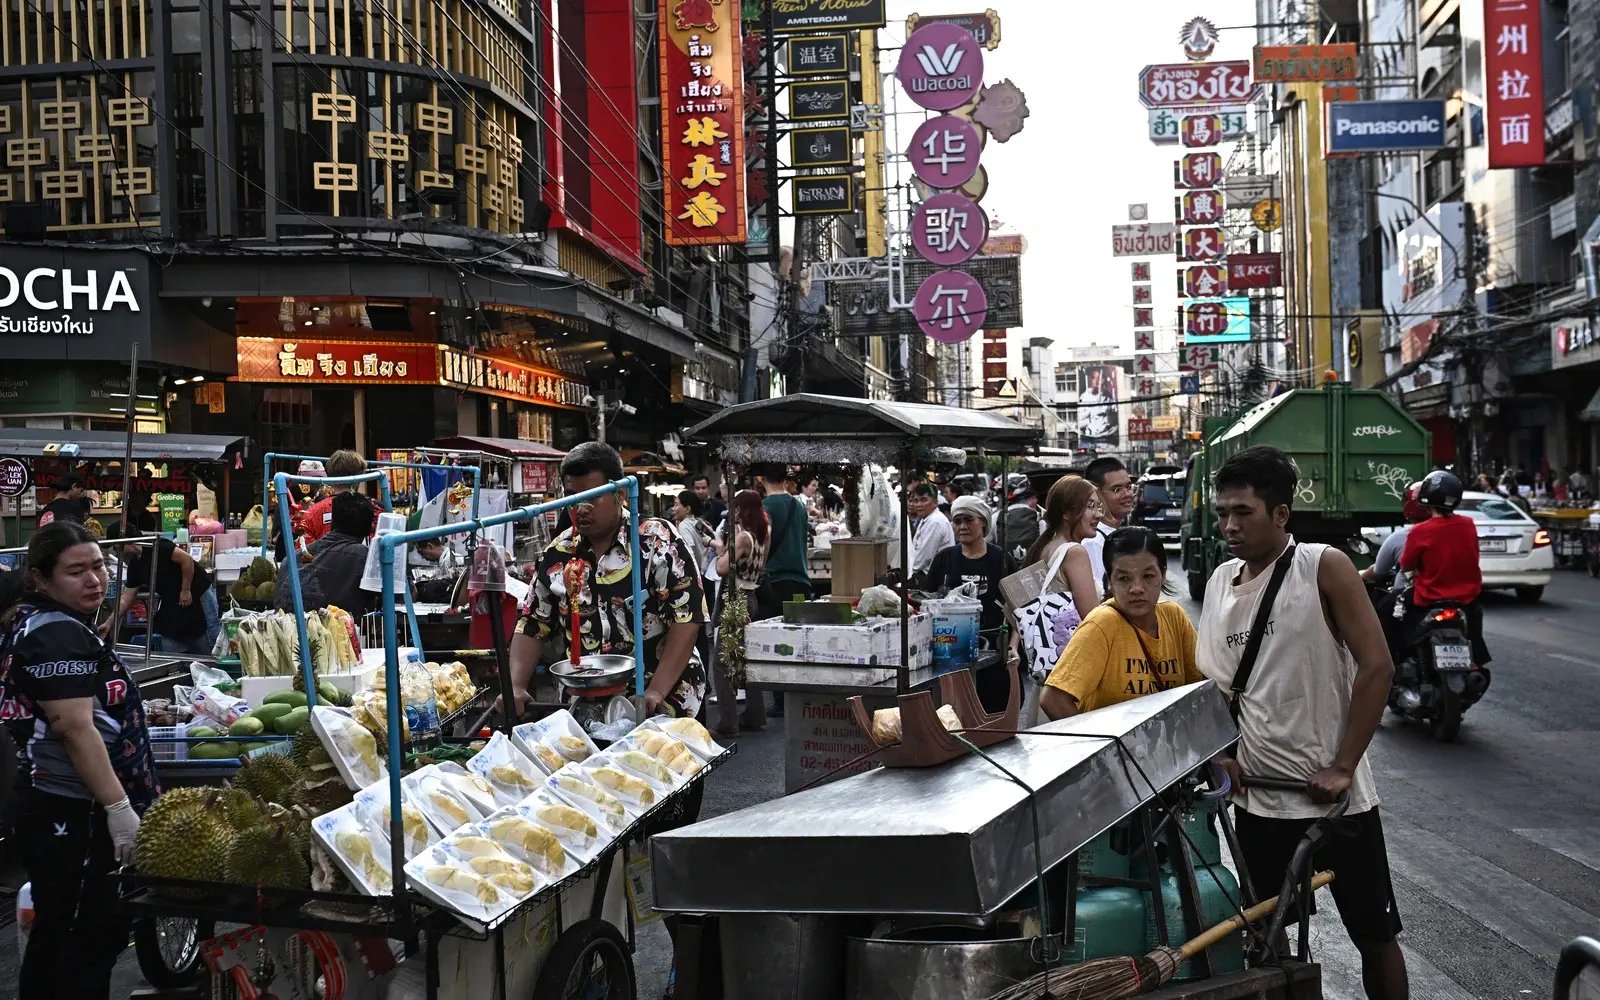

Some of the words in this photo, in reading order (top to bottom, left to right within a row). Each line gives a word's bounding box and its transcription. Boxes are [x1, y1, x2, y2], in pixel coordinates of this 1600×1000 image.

[786, 15, 848, 25] AMSTERDAM
[799, 45, 837, 65] 温室
[911, 75, 972, 93] Wacoal
[1336, 115, 1440, 138] Panasonic
[677, 115, 728, 228] 林真香
[802, 187, 840, 196] STRAIN
[922, 129, 971, 330] 华歌尔
[1192, 117, 1218, 332] 馬利興大金行
[1113, 224, 1174, 254] จินฮั้วเฮ
[1246, 264, 1275, 276] KFC
[1190, 347, 1210, 366] 行
[1226, 620, 1275, 648] PRESNT
[22, 660, 98, 679] RIDGEST
[1125, 658, 1149, 674] I'M
[1150, 658, 1178, 675] OT
[105, 678, 128, 706] R
[1122, 679, 1176, 695] ALOE
